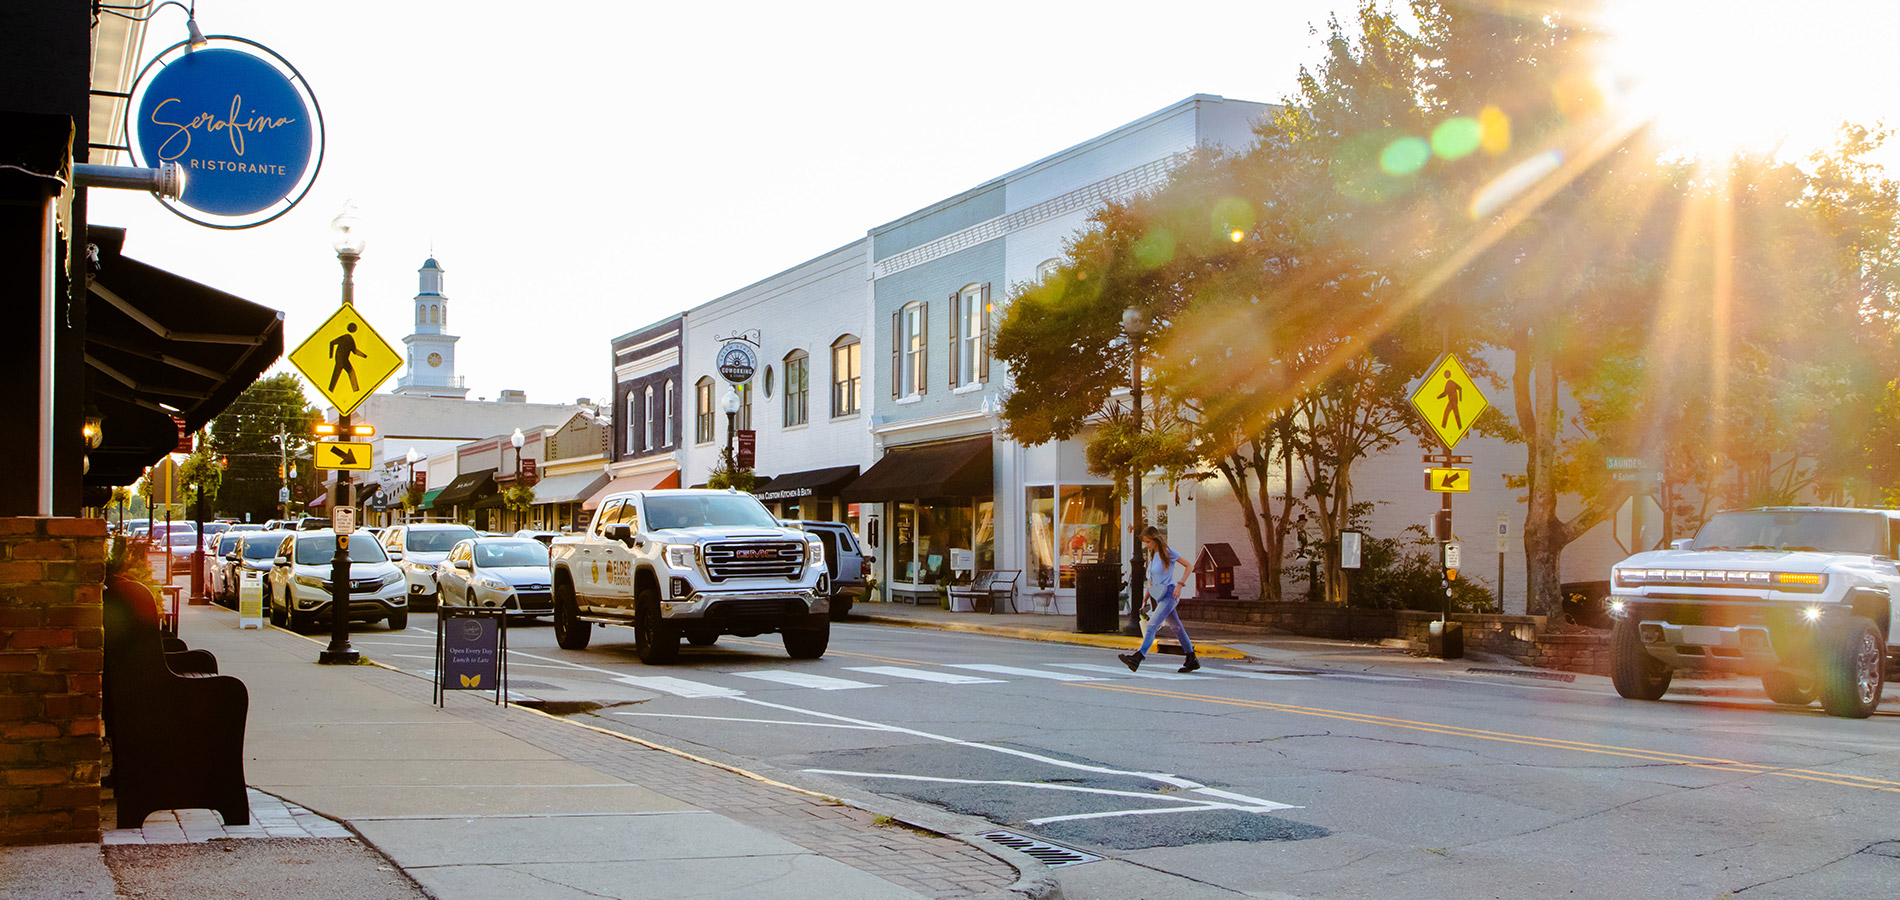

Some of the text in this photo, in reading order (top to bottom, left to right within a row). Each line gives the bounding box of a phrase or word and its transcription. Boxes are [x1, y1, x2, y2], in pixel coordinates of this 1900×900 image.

[151, 94, 296, 160] Serafina
[190, 158, 286, 176] RISTORANTE
[736, 549, 777, 558] GMC
[613, 560, 631, 576] ELDER
[613, 576, 631, 586] FLOORING
